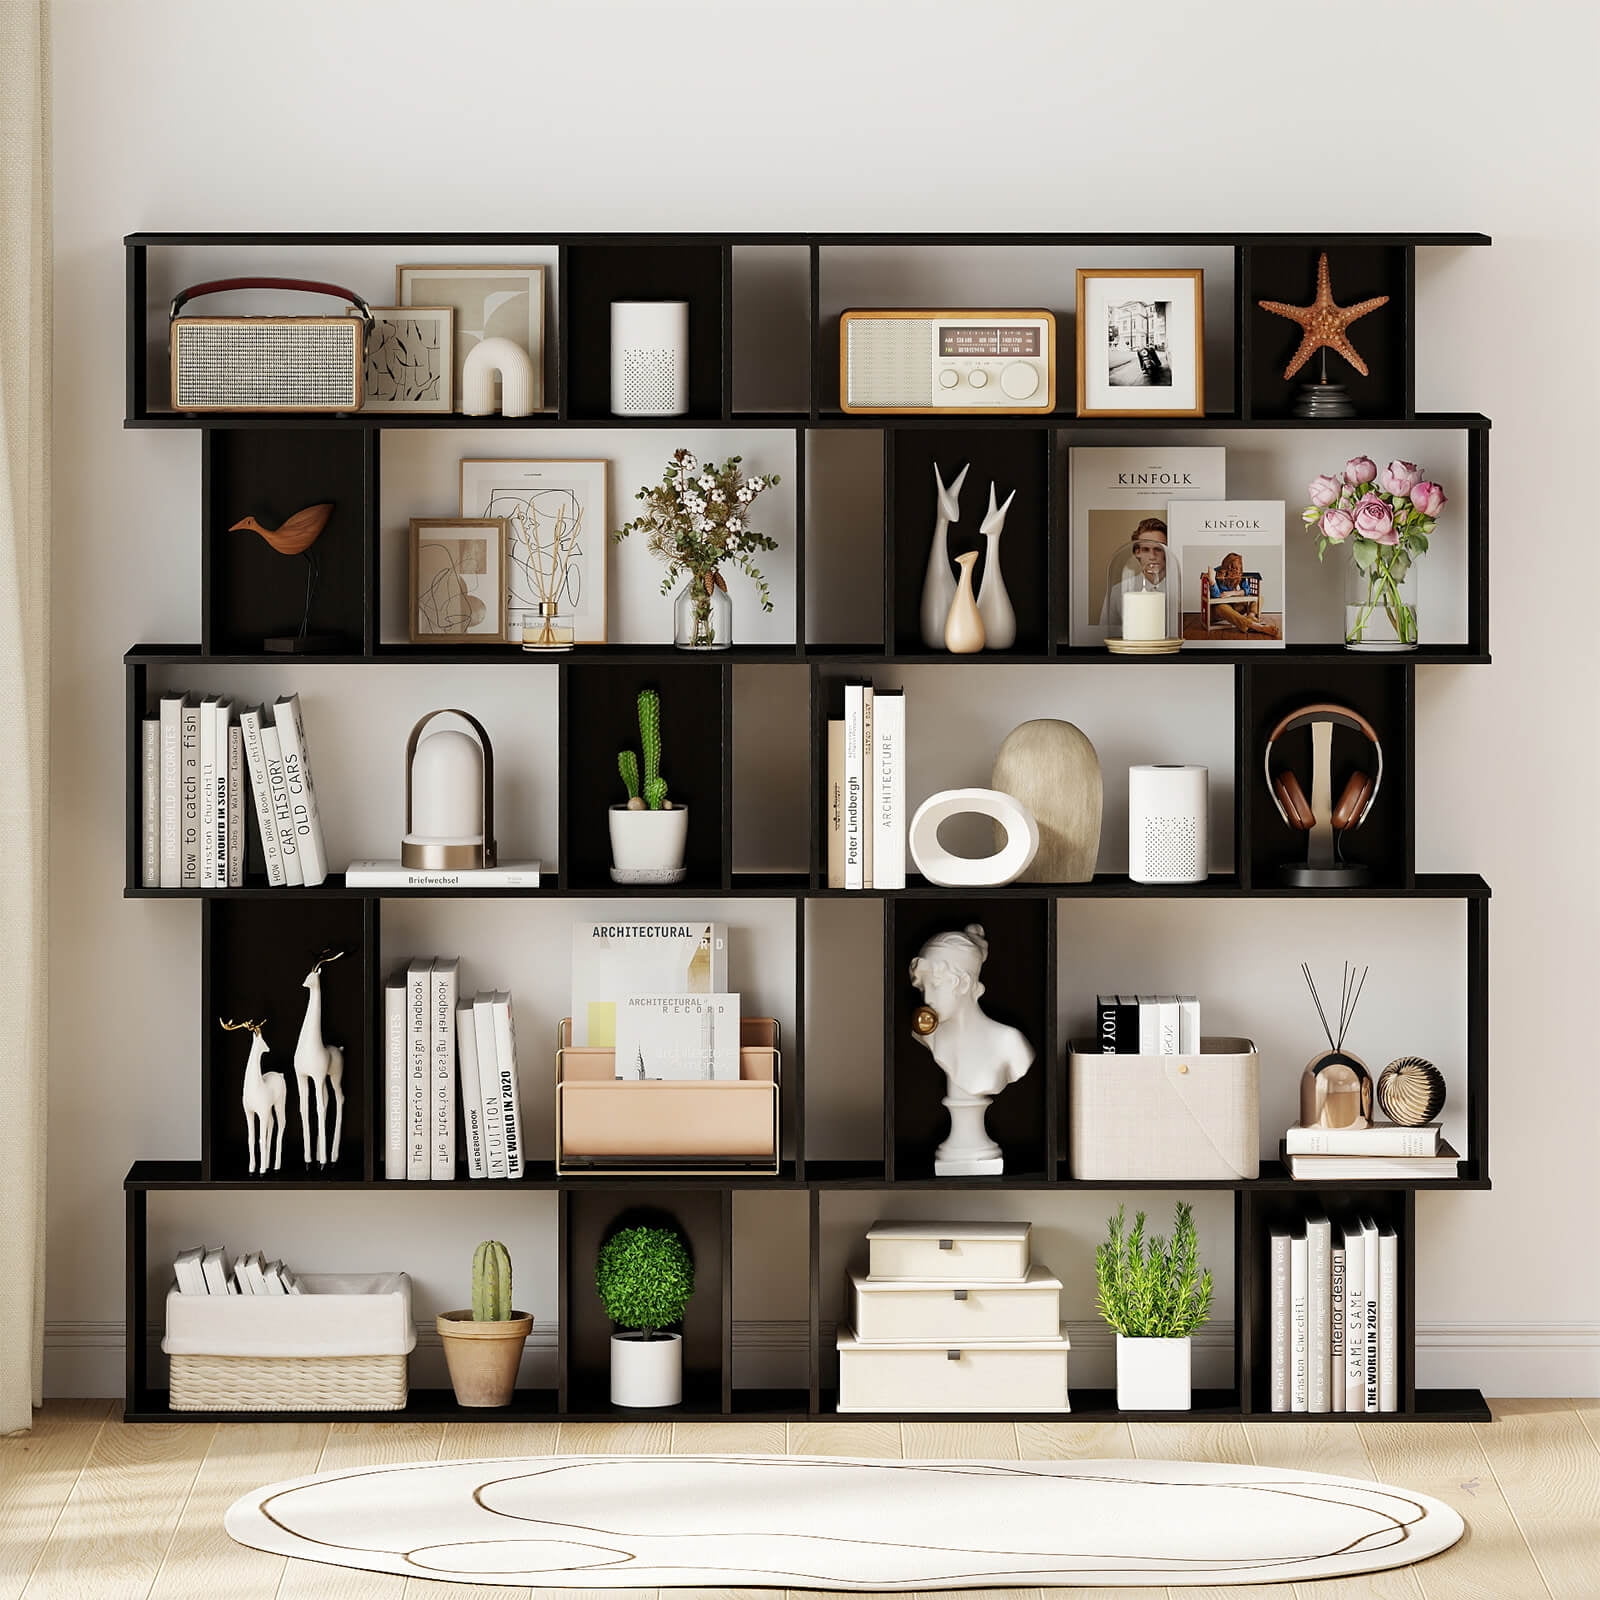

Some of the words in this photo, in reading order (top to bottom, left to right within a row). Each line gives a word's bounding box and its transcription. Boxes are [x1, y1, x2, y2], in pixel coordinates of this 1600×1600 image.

[1119, 474, 1192, 484] KINFOLK
[1205, 520, 1260, 528] KINFOLK
[184, 715, 196, 748] fish
[246, 717, 261, 763] children
[165, 726, 176, 788] DECORATES
[187, 759, 196, 767] a
[253, 769, 264, 785] for
[268, 759, 289, 819] HISTORY
[285, 754, 302, 794] CARS
[882, 734, 892, 827] ARCHITECTURE
[184, 776, 196, 818] catch
[204, 763, 213, 824] Churchill
[258, 791, 269, 814] Book
[848, 776, 859, 832] Lindbergh
[165, 795, 176, 858] HOUSEHOLD
[185, 828, 196, 844] to
[231, 814, 239, 825] by
[264, 819, 273, 842] DRAW
[295, 805, 310, 835] OLD
[204, 831, 213, 879] Winston
[230, 830, 238, 851] Jobs
[269, 847, 276, 858] TO
[281, 828, 296, 855] CAR
[848, 837, 857, 865] Peter
[184, 854, 196, 879] How
[272, 864, 281, 881] HOW
[592, 927, 692, 937] ARCHITECTURAL
[413, 981, 422, 1033] Handbook
[629, 998, 702, 1006] ARCHITECTURAL
[391, 1014, 401, 1078] DECORATES
[413, 1039, 425, 1078] Design
[501, 1071, 512, 1098] 2020
[391, 1085, 401, 1150] HOUSEHOLD
[413, 1085, 422, 1136] Interior
[503, 1101, 513, 1111] IN
[486, 1096, 503, 1173] INTUITION
[504, 1114, 517, 1152] WORLD
[413, 1144, 422, 1163] The
[508, 1154, 519, 1173] THE
[1331, 1256, 1345, 1303] design
[1296, 1297, 1304, 1353] Churchill
[1350, 1290, 1362, 1329] SAME
[1367, 1301, 1376, 1329] 2020
[1331, 1307, 1342, 1357] Interior
[1368, 1332, 1376, 1343] IN
[1350, 1338, 1362, 1377] SAME
[1368, 1346, 1376, 1385] WORLD
[1296, 1359, 1304, 1404] Winston
[1368, 1387, 1376, 1407] THE
